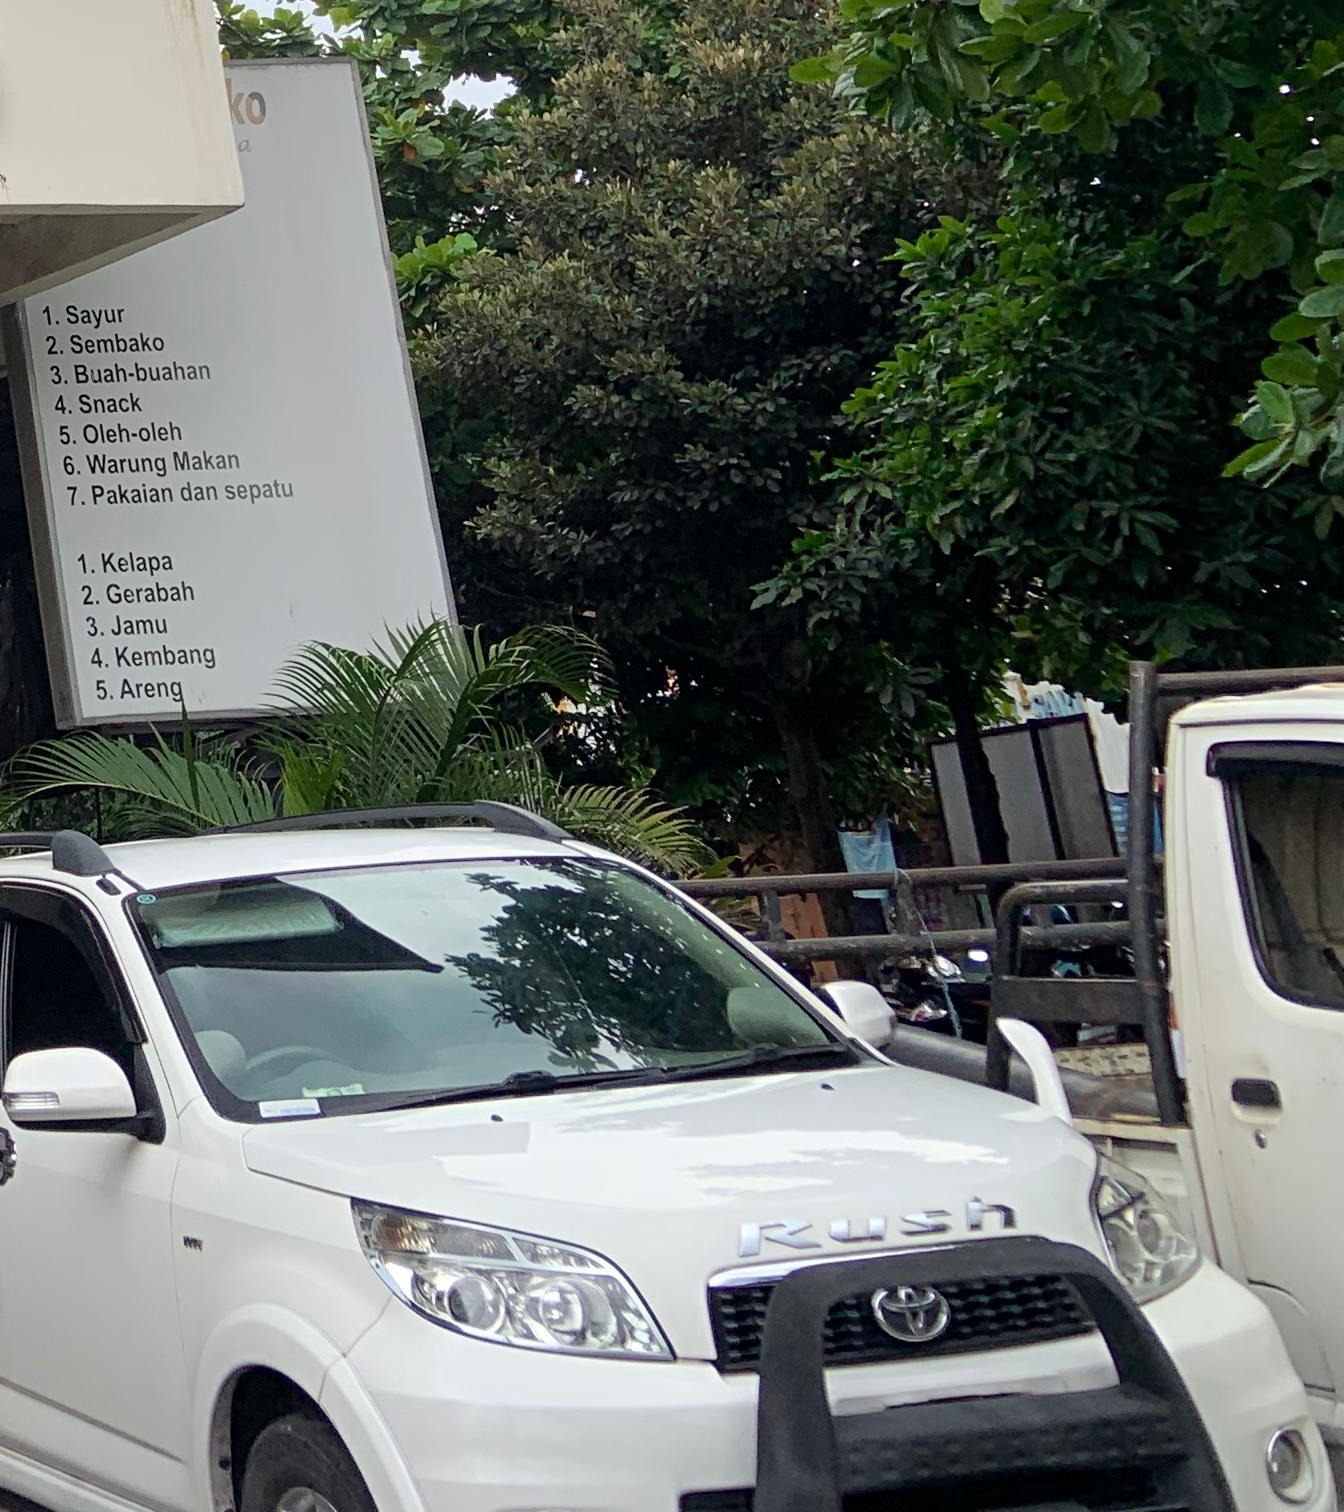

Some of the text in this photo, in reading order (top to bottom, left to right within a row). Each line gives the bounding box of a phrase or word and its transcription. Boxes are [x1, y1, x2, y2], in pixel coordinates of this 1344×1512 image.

[42, 304, 125, 329] 1. Sayur
[45, 332, 165, 355] 2. Sembako
[50, 361, 211, 385] 3. Buah-buahan
[54, 392, 143, 415] 4. Snack
[59, 421, 183, 445] 5. Oleh-oleh
[63, 450, 240, 477] 6. Warung Makan
[66, 479, 294, 506] 7. Pakaian dan sepatu
[77, 552, 174, 576] 1. Kelapa
[81, 581, 195, 605] 2. Gerabah
[85, 615, 168, 637] 3. Jamu
[90, 645, 216, 669] 4. Kembang
[96, 678, 184, 702] 5. Areng
